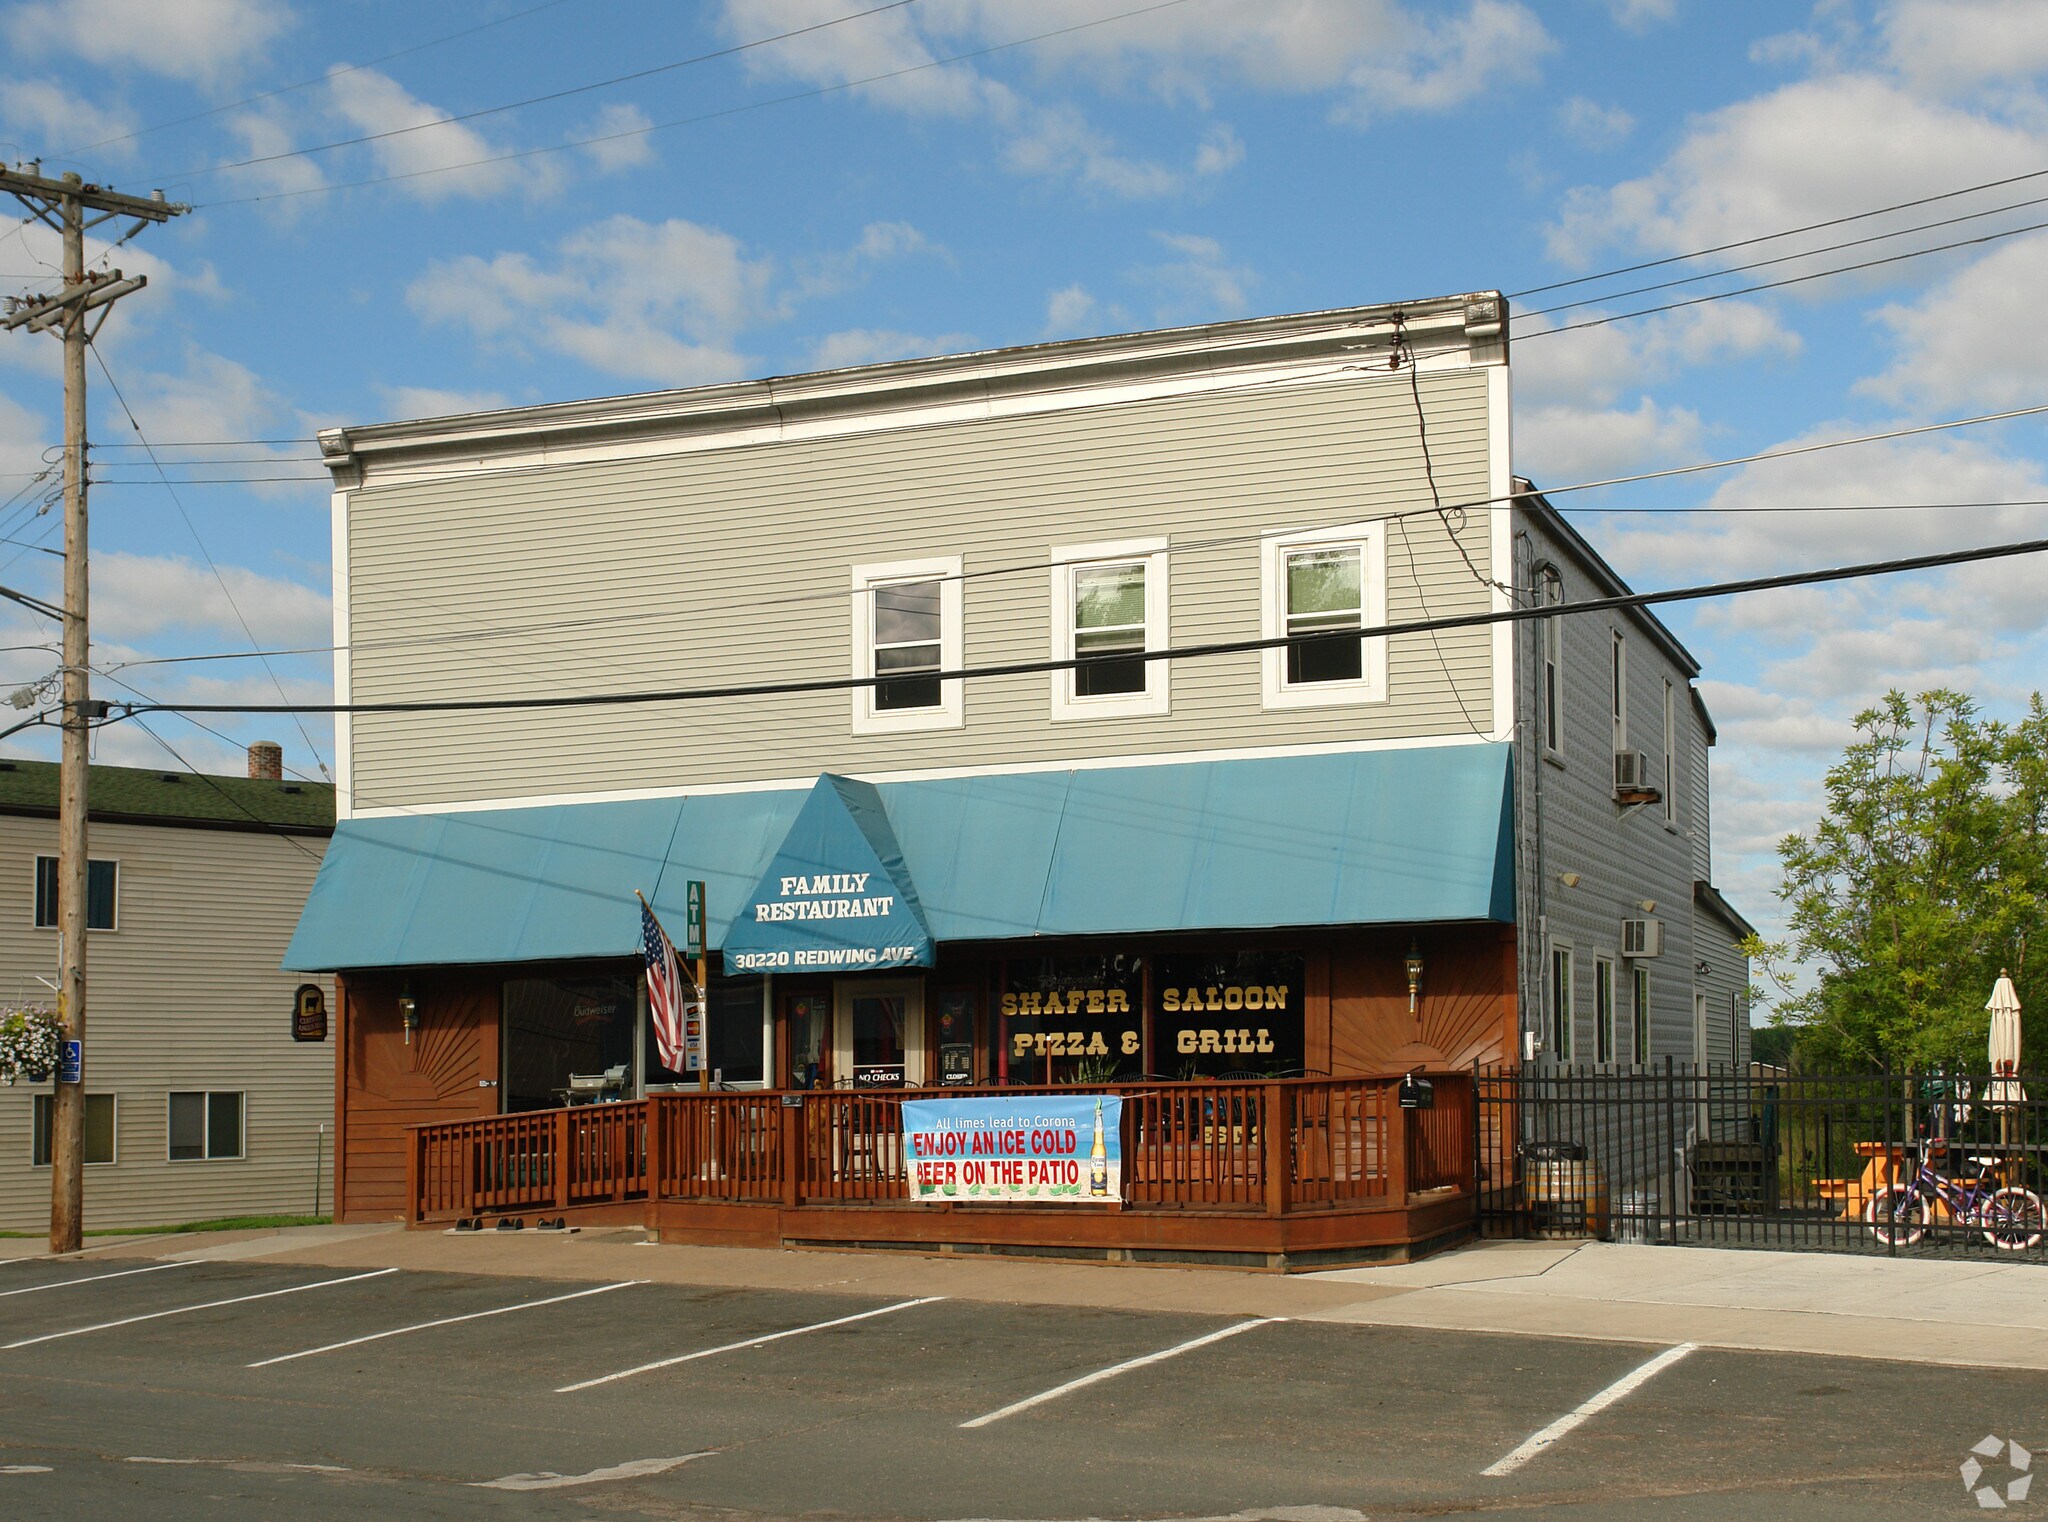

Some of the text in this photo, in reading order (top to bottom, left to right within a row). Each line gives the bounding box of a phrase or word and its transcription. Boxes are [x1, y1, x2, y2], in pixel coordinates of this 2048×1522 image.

[780, 872, 870, 896] FAMILY
[689, 883, 700, 943] ATM
[755, 896, 893, 922] RESTAURANT
[735, 946, 918, 969] 30220 REDWING AVE.
[574, 1004, 617, 1017] Budweiser
[1001, 985, 1289, 1016] SHAFER SALOON
[1013, 1028, 1275, 1058] PIZZA & GRILL
[872, 1073, 900, 1082] CHECKS
[936, 1115, 1076, 1129] All limes lead to Corona
[913, 1129, 1077, 1157] ENJOY AN ICE COLD
[917, 1161, 957, 1185] BEER
[963, 1161, 986, 1185] ON
[990, 1160, 1023, 1185] THE
[1028, 1160, 1079, 1185] PATIO
